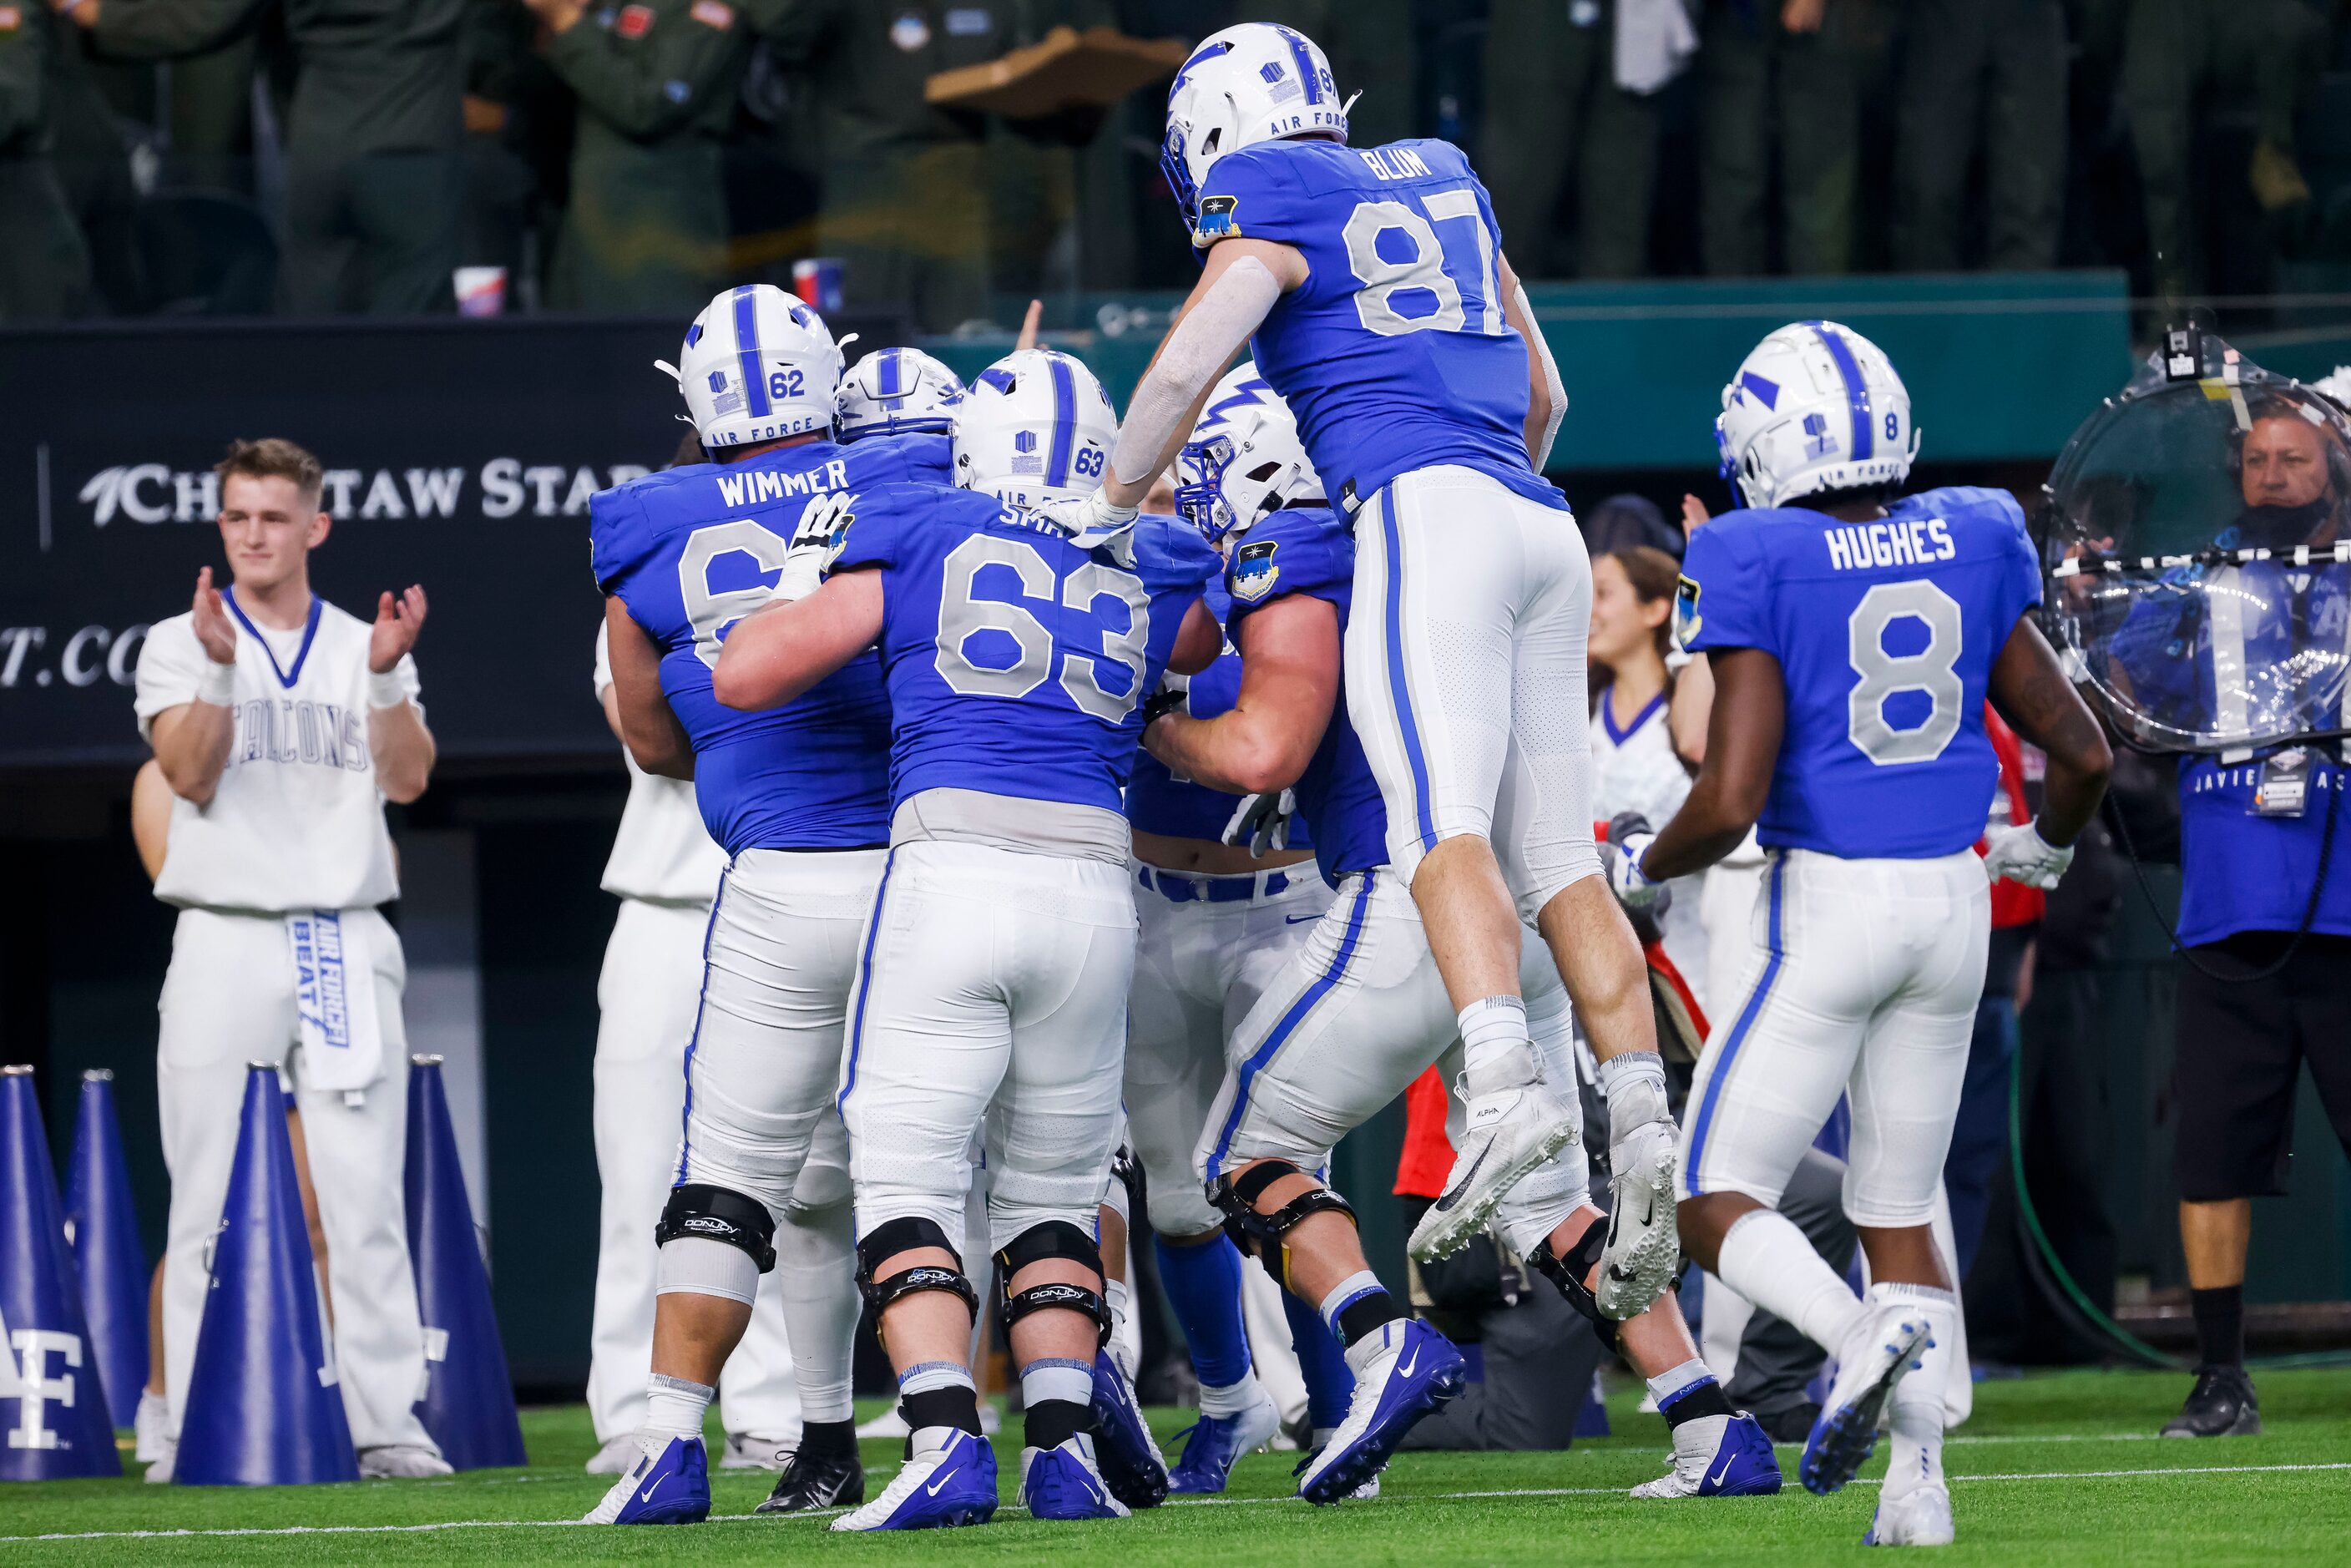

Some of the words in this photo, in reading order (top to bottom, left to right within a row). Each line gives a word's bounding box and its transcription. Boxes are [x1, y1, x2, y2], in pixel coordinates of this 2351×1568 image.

[1271, 116, 1302, 134] AIR
[1359, 149, 1433, 181] BLUM
[1342, 189, 1502, 336] 87
[769, 369, 805, 400] 62
[712, 432, 739, 446] AIR
[751, 417, 812, 440] FORCE
[1885, 412, 1898, 441] 8
[1074, 448, 1105, 478] 63
[121, 463, 465, 520] CHTAW
[480, 458, 671, 518] STA
[716, 459, 850, 508] WIMMER
[996, 489, 1027, 505] AIR
[1823, 518, 1956, 570] HUGHES
[678, 518, 786, 671] 6
[934, 533, 1151, 726] 63
[1848, 578, 1964, 766] 8
[2195, 769, 2255, 793] JAVIE
[294, 921, 316, 1006] BEAT
[1476, 1107, 1499, 1118] ALPHA
[685, 1219, 739, 1234] DONJOY
[907, 1271, 957, 1283] DONJOY
[1030, 1288, 1084, 1300] DONJOY
